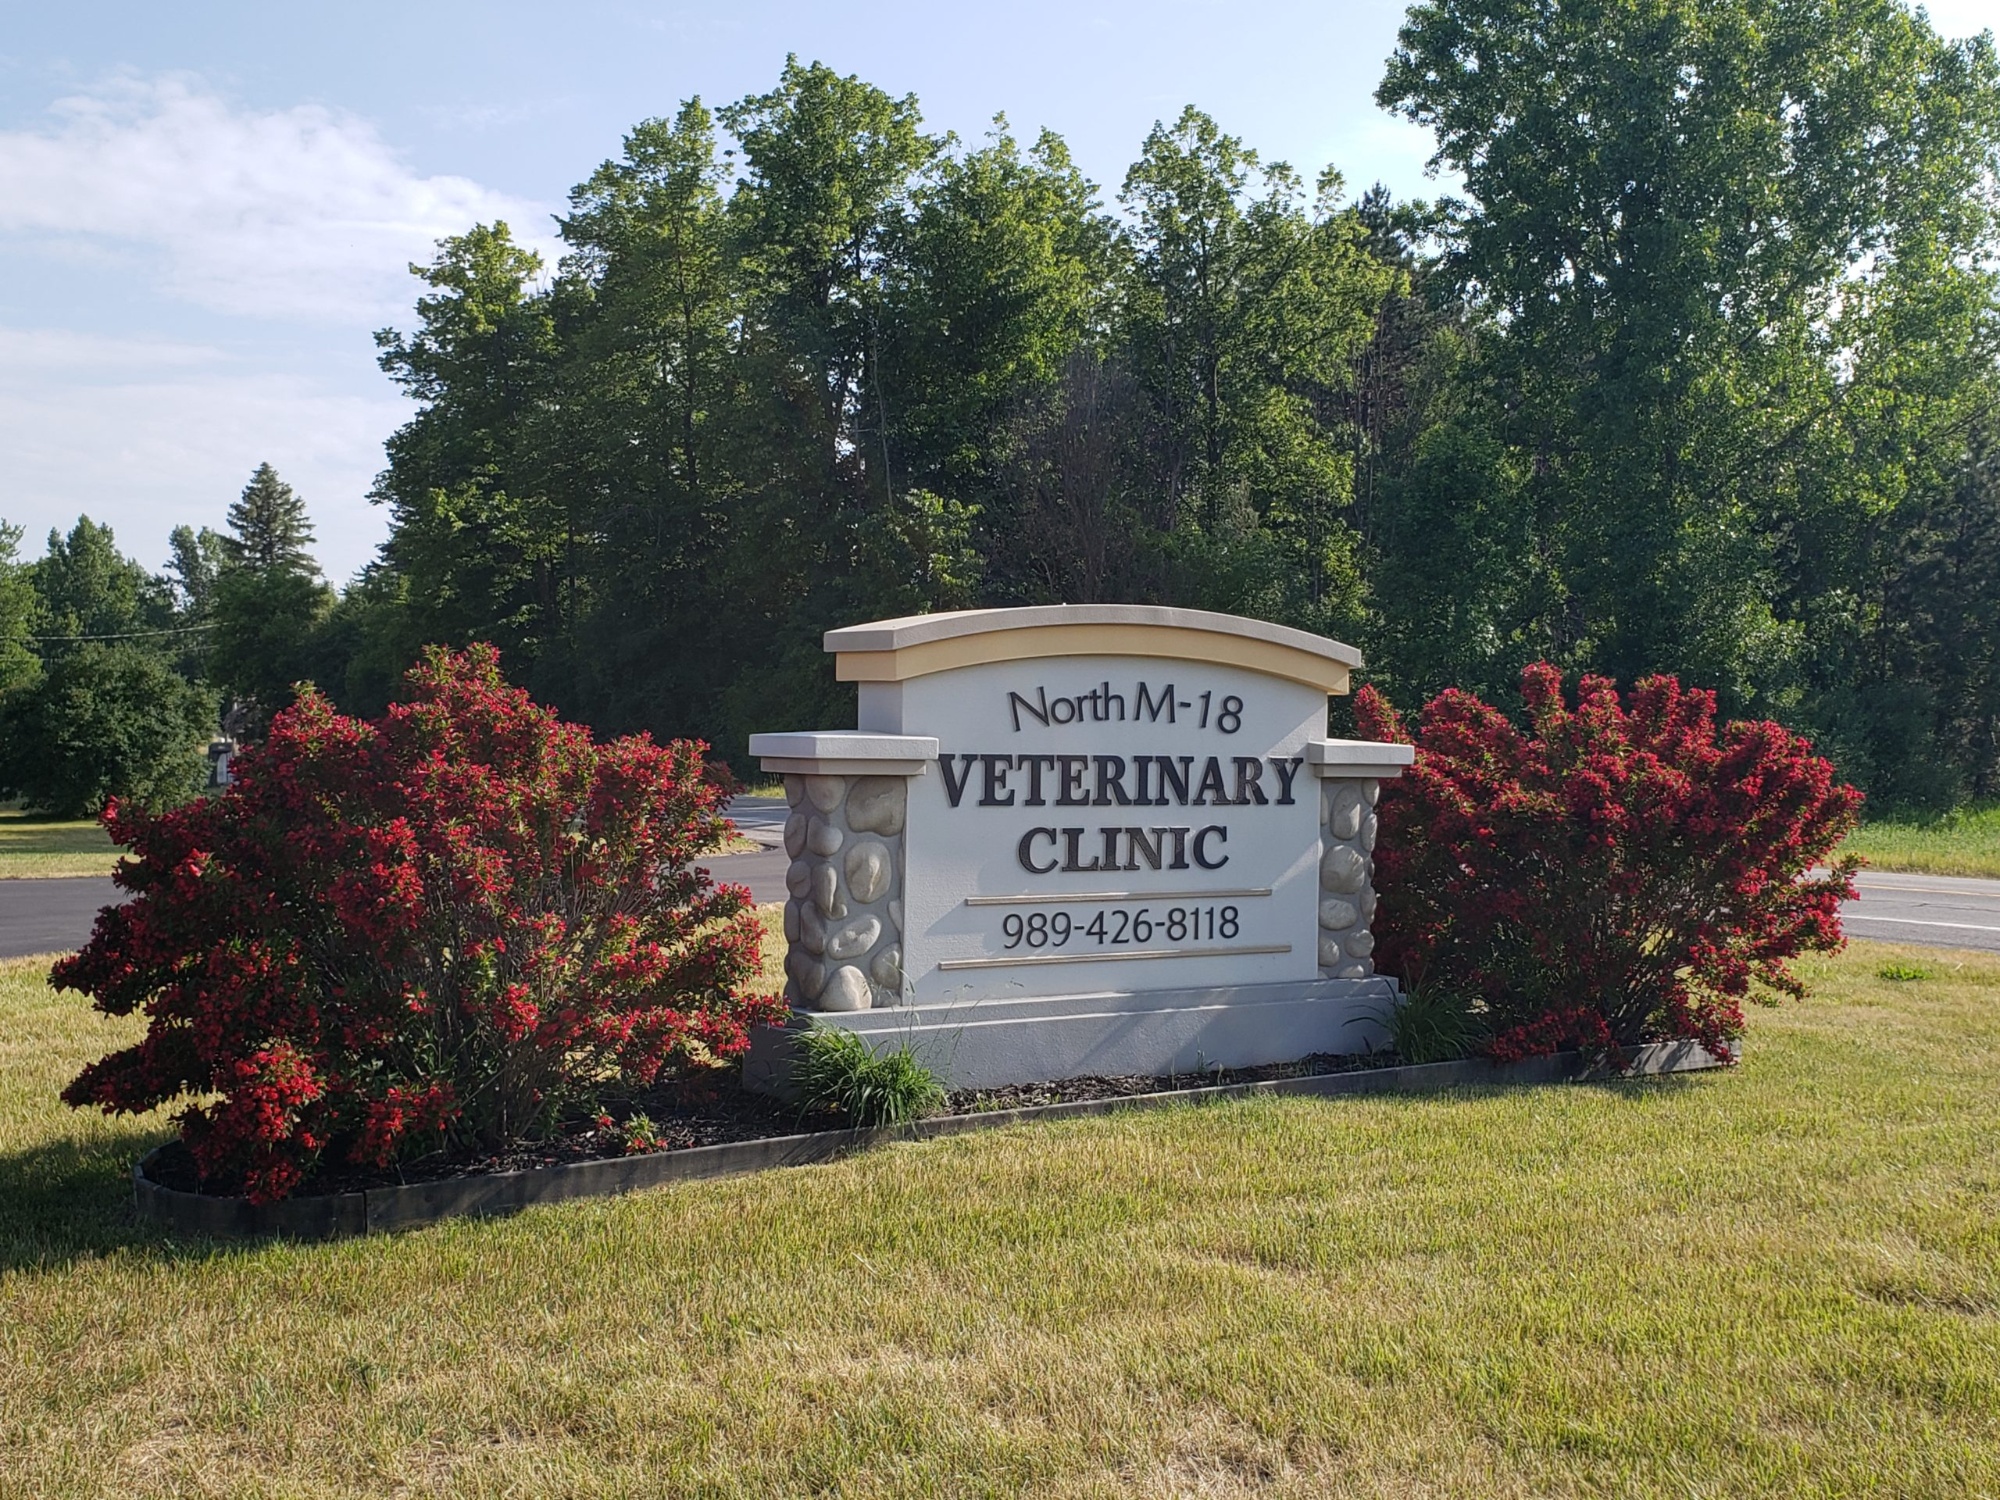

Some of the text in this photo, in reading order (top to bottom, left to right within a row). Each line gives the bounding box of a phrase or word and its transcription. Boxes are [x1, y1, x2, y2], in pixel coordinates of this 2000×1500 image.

[1008, 681, 1244, 735] North M-18
[938, 753, 1304, 808] VETERINARY
[1017, 825, 1230, 875] CLINIC
[1002, 905, 1240, 950] 989-426-8118
